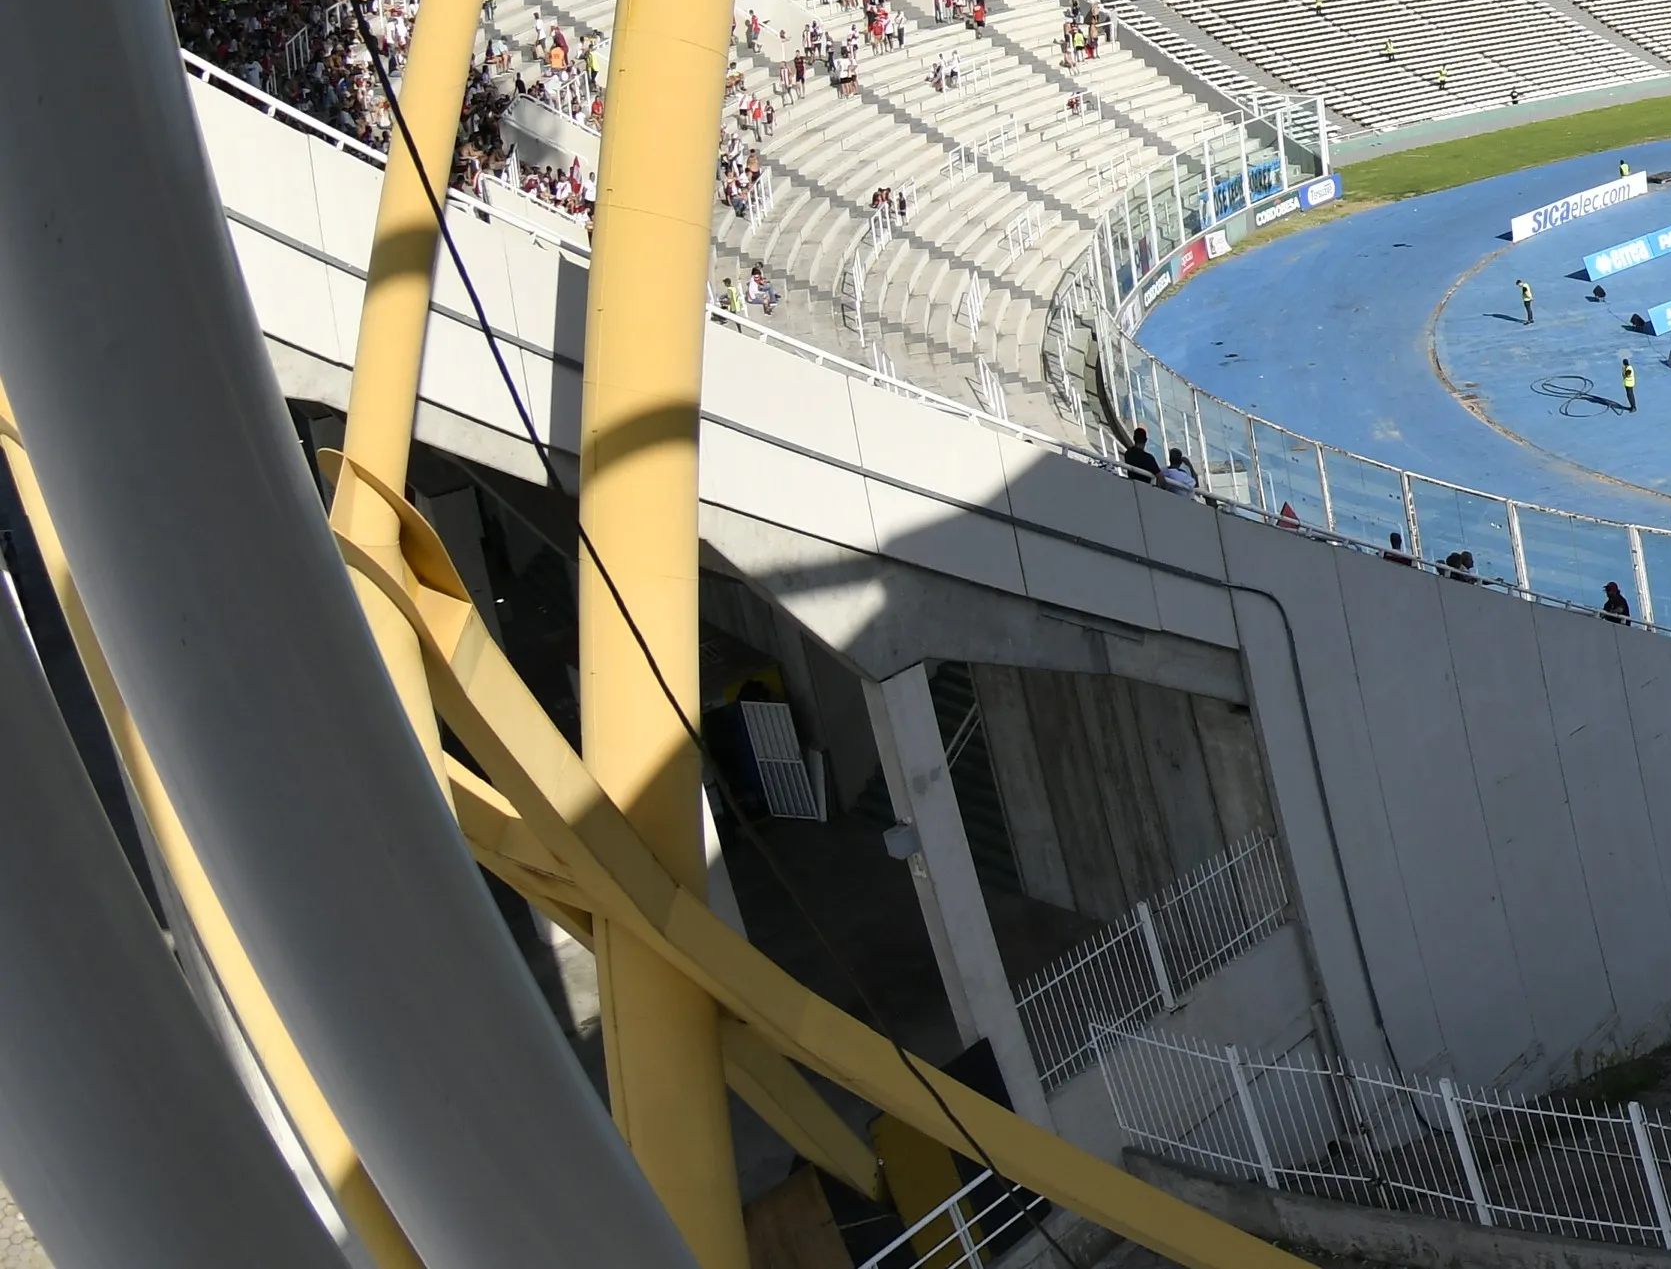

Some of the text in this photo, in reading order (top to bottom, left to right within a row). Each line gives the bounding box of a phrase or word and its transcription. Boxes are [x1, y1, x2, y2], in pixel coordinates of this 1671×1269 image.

[1256, 196, 1300, 226] CORDOBESA
[1532, 183, 1631, 234] sicaelec.com
[1144, 271, 1171, 308] CORDOBESA
